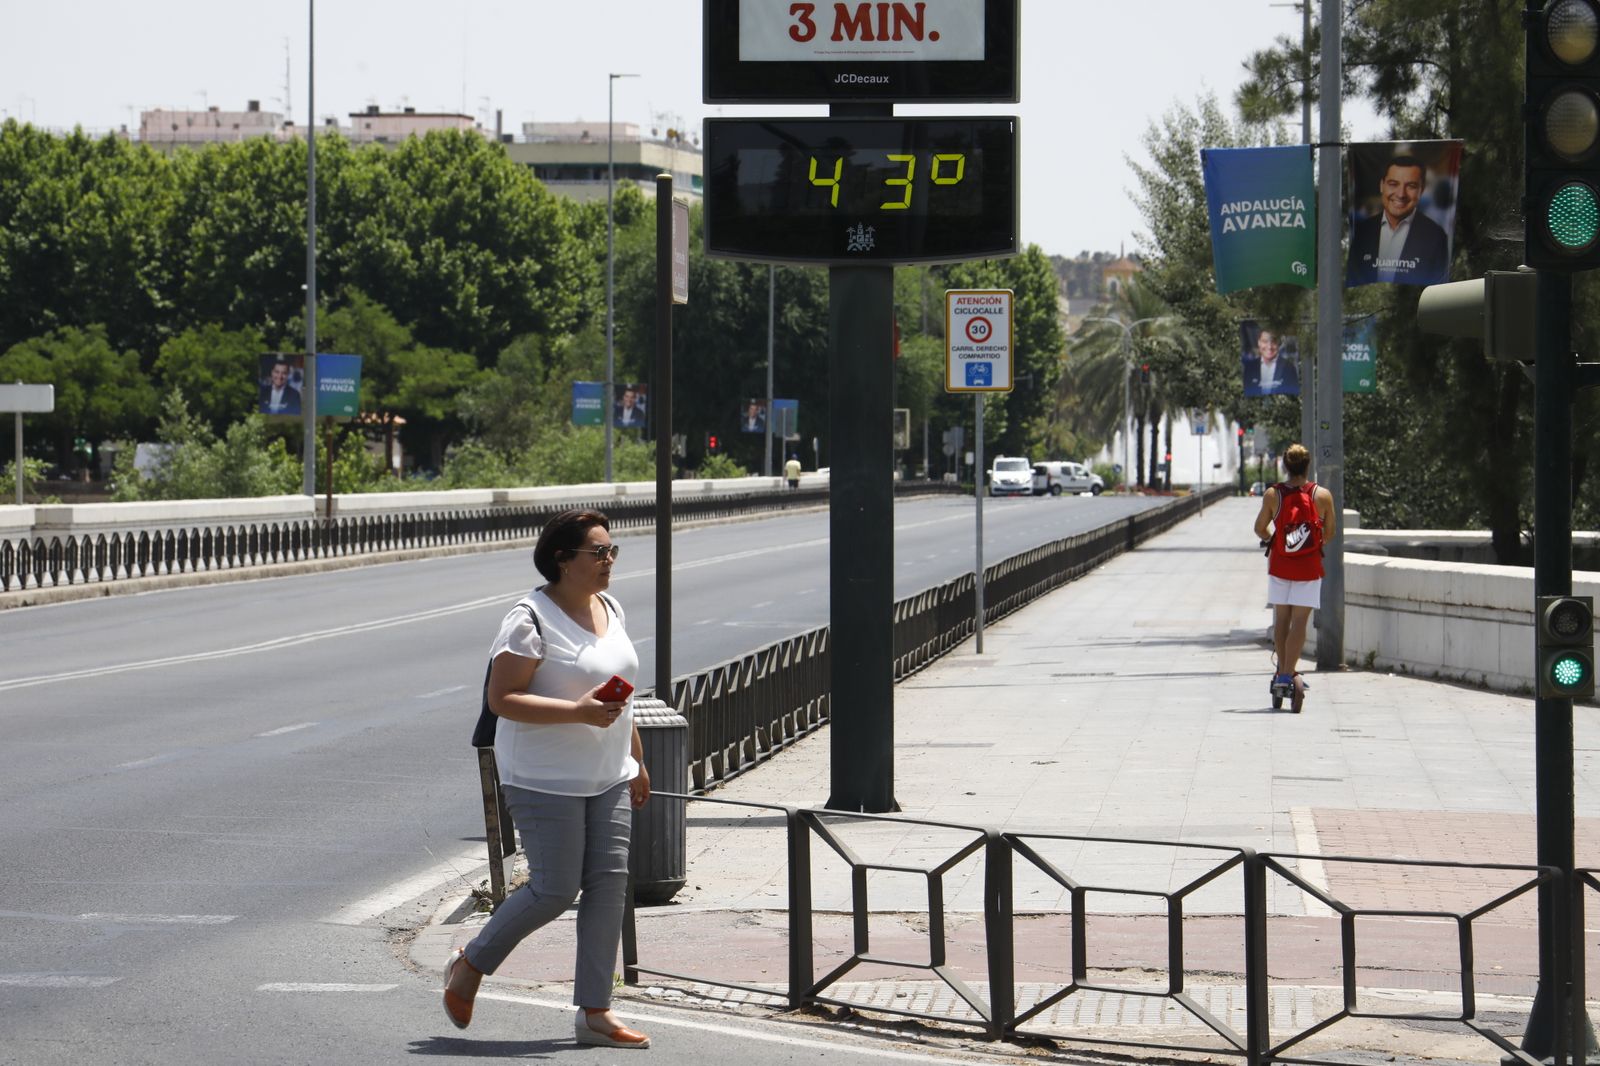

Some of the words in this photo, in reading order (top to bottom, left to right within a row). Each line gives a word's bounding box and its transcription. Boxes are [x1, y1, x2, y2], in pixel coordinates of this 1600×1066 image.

[789, 2, 817, 42] 3
[830, 2, 940, 42] MIN.
[834, 73, 889, 84] JCDecaux
[1220, 196, 1306, 216] ANDALUCÍA
[1222, 212, 1306, 234] AVANZA
[1372, 257, 1416, 269] Juanma
[956, 296, 1002, 305] ATENCIÓN
[954, 307, 1003, 315] CICLOCALLE
[971, 325, 987, 335] 30
[1342, 351, 1370, 361] ANZA
[320, 383, 355, 393] AVANZA
[1286, 523, 1307, 547] NIKE
